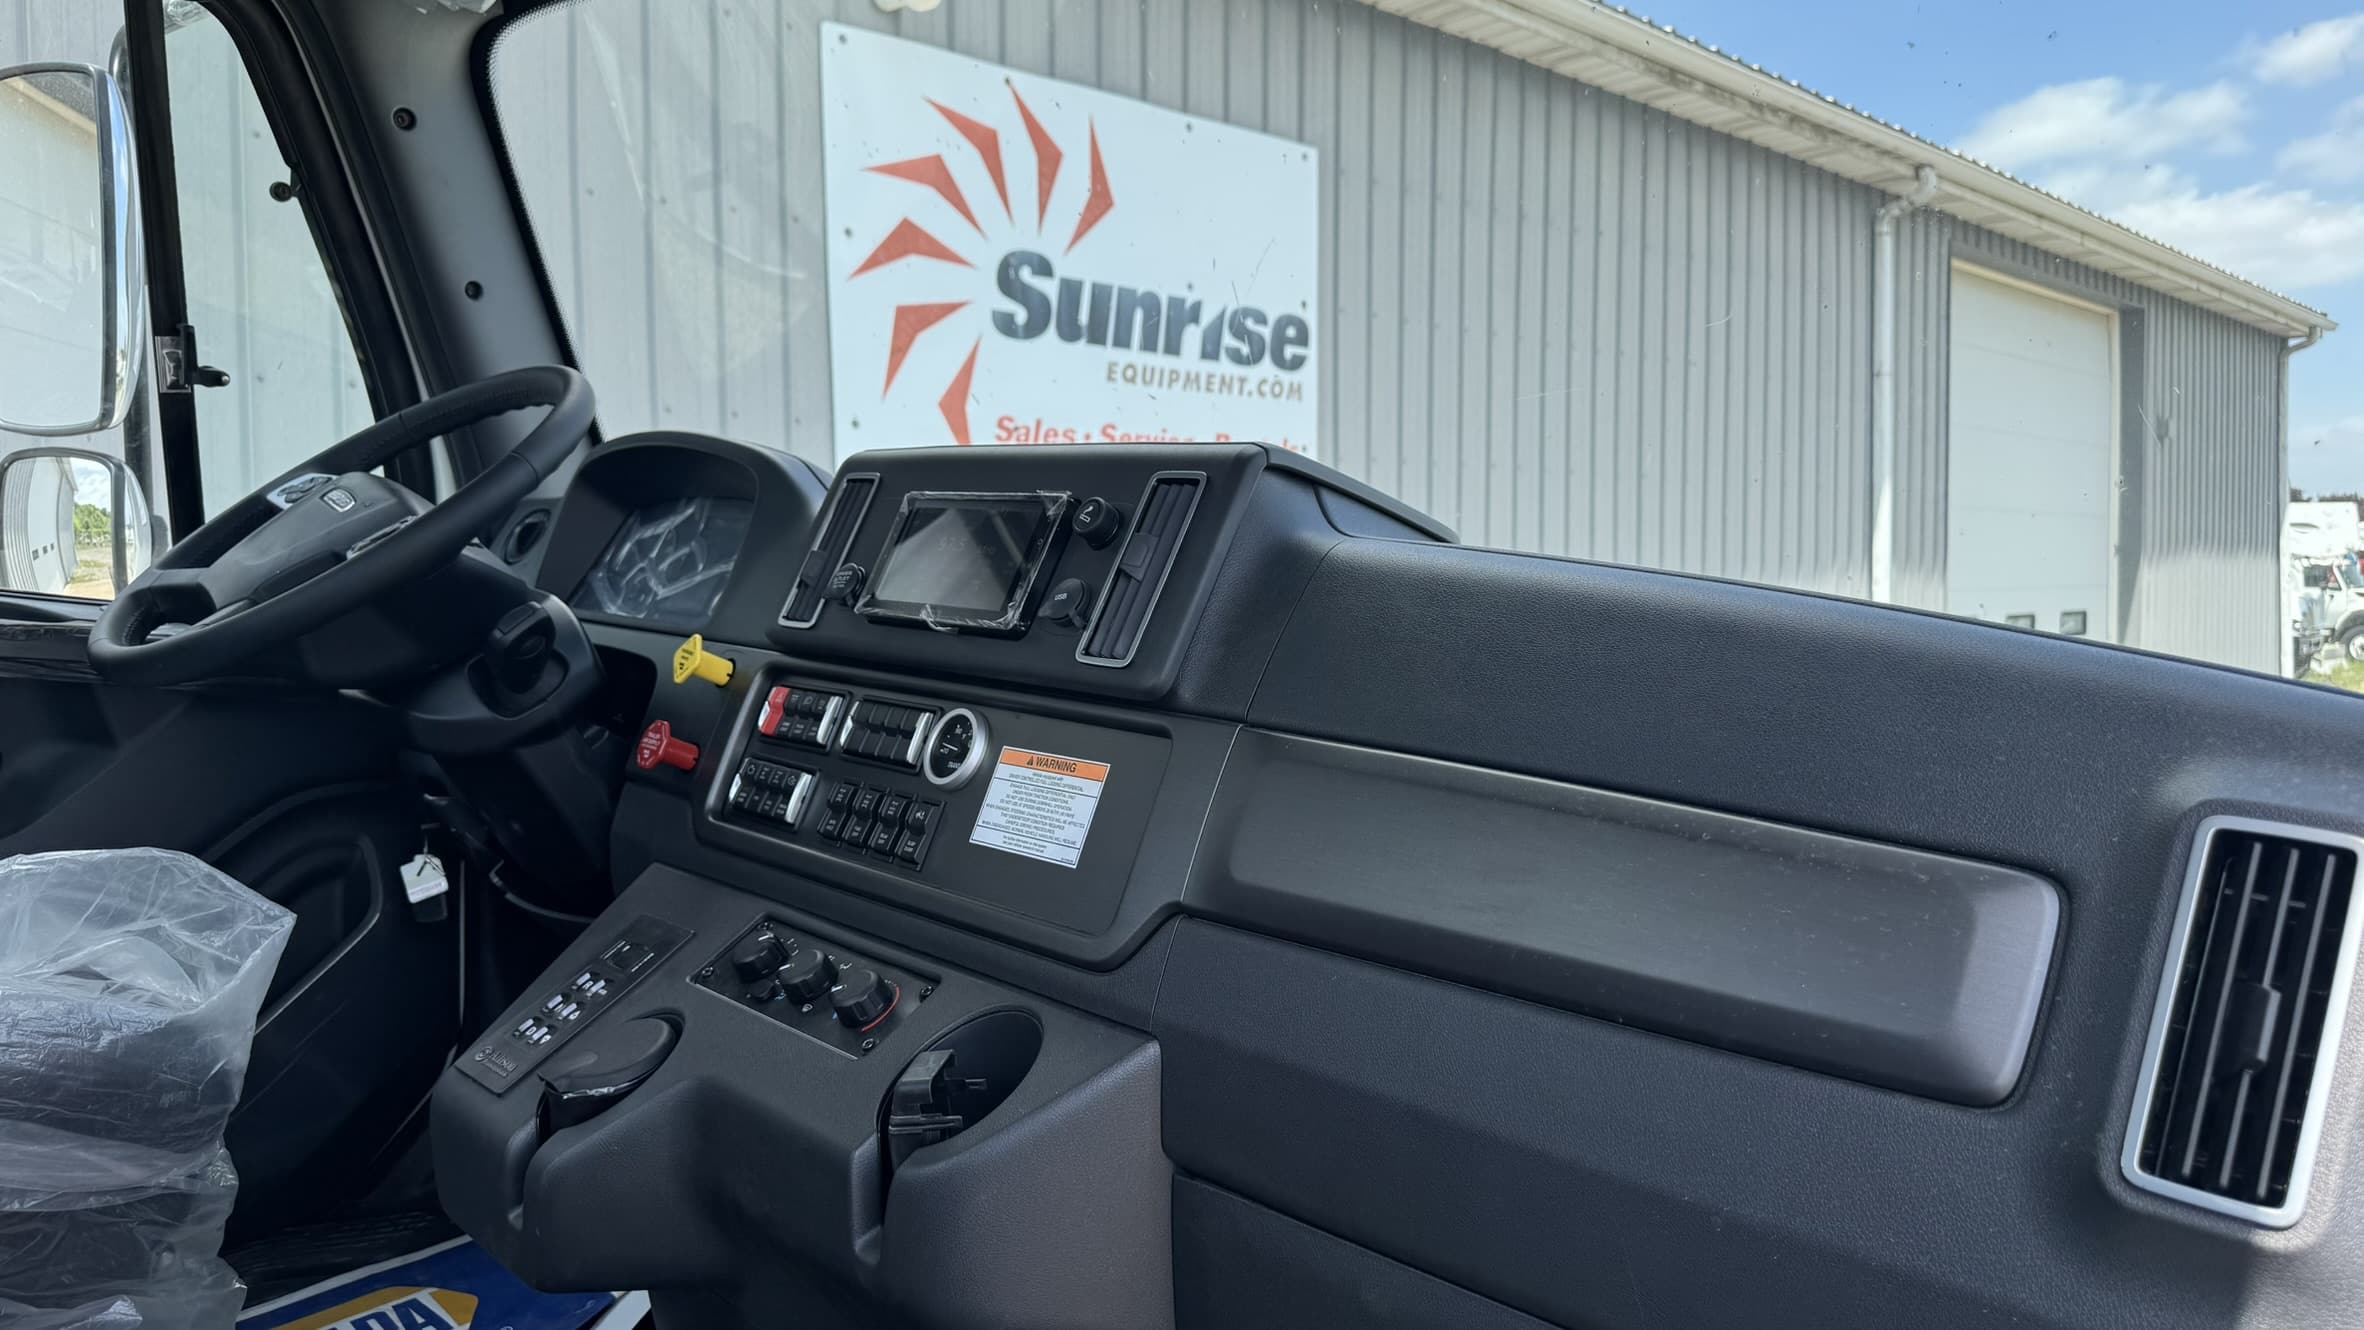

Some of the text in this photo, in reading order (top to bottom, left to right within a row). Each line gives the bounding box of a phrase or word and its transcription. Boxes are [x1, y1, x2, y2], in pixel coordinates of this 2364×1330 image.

[992, 250, 1309, 371] Sunrise
[1107, 362, 1303, 400] EQUIPMENT.COM
[1035, 756, 1078, 774] WARNING
